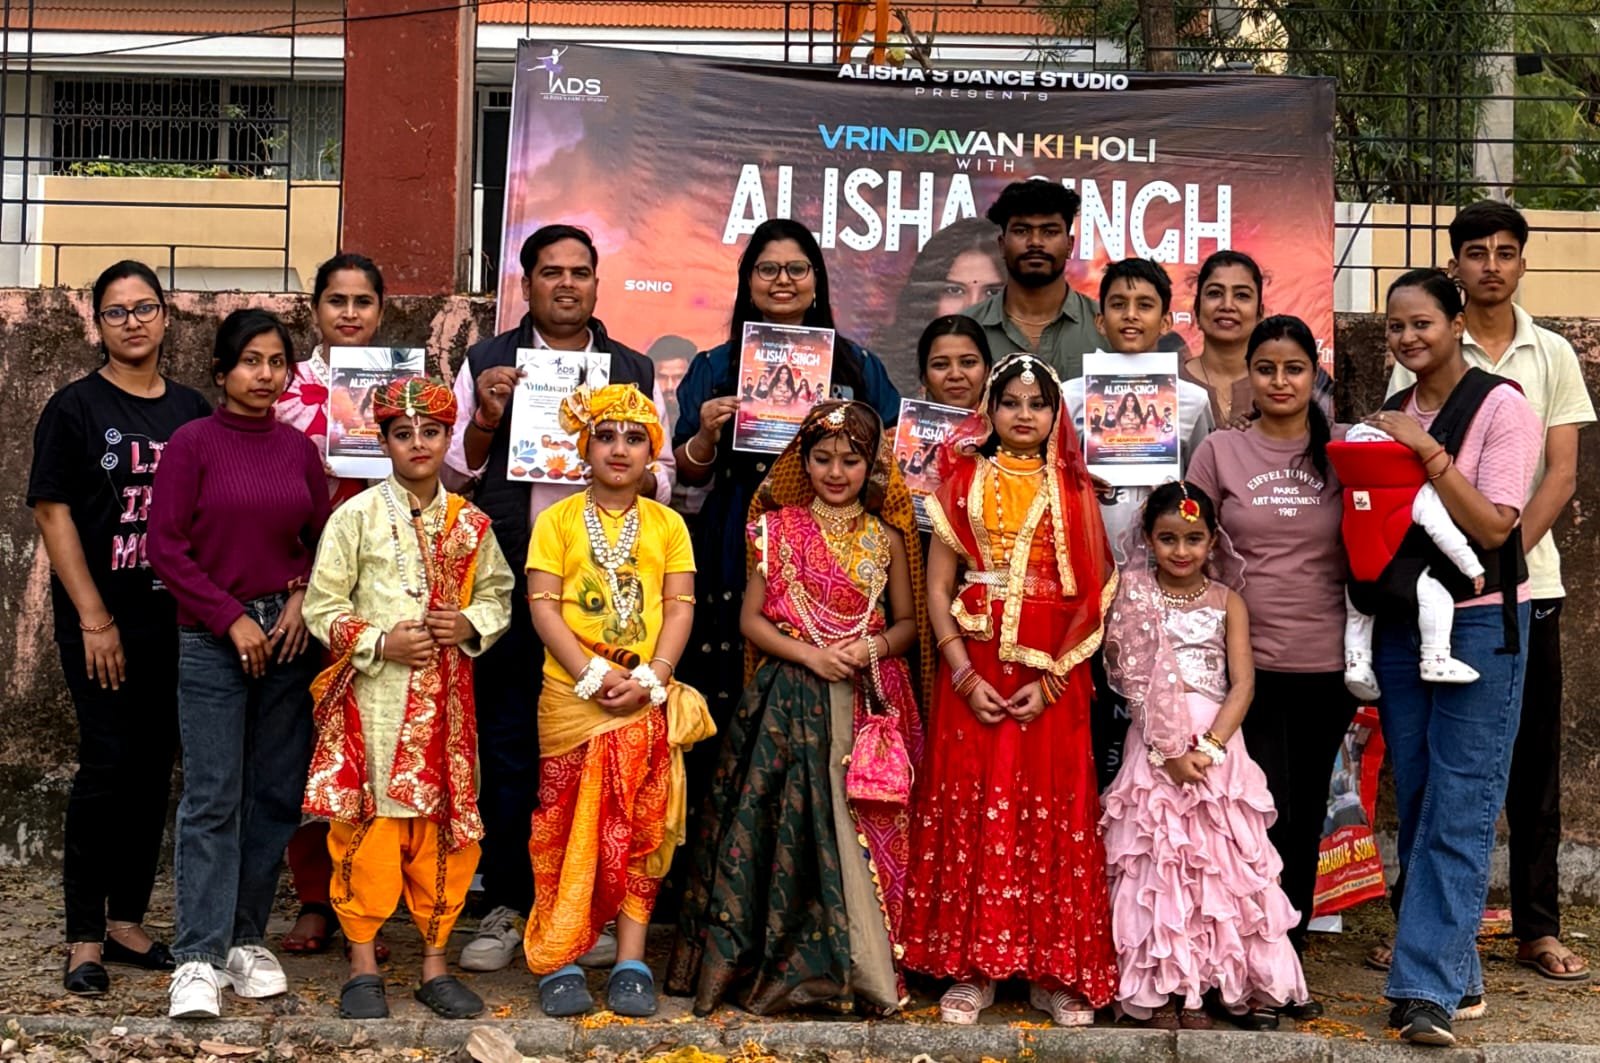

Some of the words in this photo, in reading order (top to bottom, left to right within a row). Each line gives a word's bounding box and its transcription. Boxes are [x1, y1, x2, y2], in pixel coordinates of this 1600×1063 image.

[837, 64, 948, 83] ALISHA'S
[953, 70, 1035, 87] DANCE
[1040, 72, 1129, 91] STUDIO
[550, 77, 601, 95] ADS
[914, 87, 1048, 101] PRESENTS
[818, 124, 1024, 157] VRINDAVAN
[1033, 133, 1064, 159] KI
[1074, 135, 1156, 163] HOLI
[956, 158, 1014, 173] WITH
[722, 164, 977, 253] ALISHA
[1026, 174, 1231, 265] NGH
[624, 279, 673, 292] SONIC
[754, 348, 787, 363] ALISHA
[909, 424, 944, 443] ALISHA
[1247, 470, 1284, 491] EIFFEL
[1284, 468, 1324, 491] TOWER
[1273, 486, 1299, 495] PARIS
[1252, 496, 1268, 505] ART
[1270, 496, 1321, 505] MONUMENT
